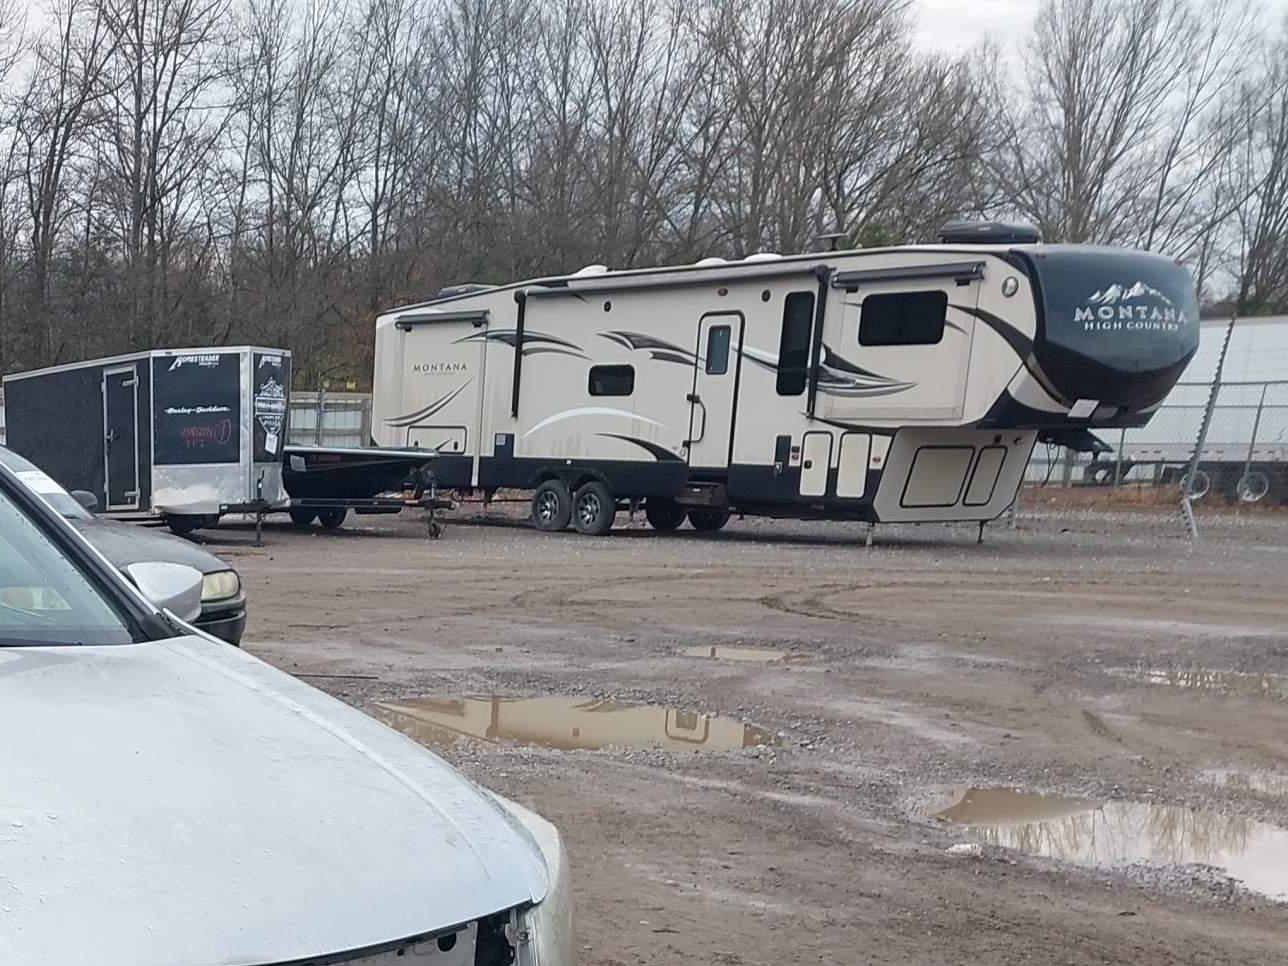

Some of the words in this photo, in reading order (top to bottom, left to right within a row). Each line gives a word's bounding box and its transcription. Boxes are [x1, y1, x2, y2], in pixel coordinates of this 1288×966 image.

[1073, 305, 1188, 323] MONTANA
[1084, 321, 1122, 331] HIGH
[1126, 321, 1178, 331] COUNTRY
[413, 362, 468, 373] MONTANA
